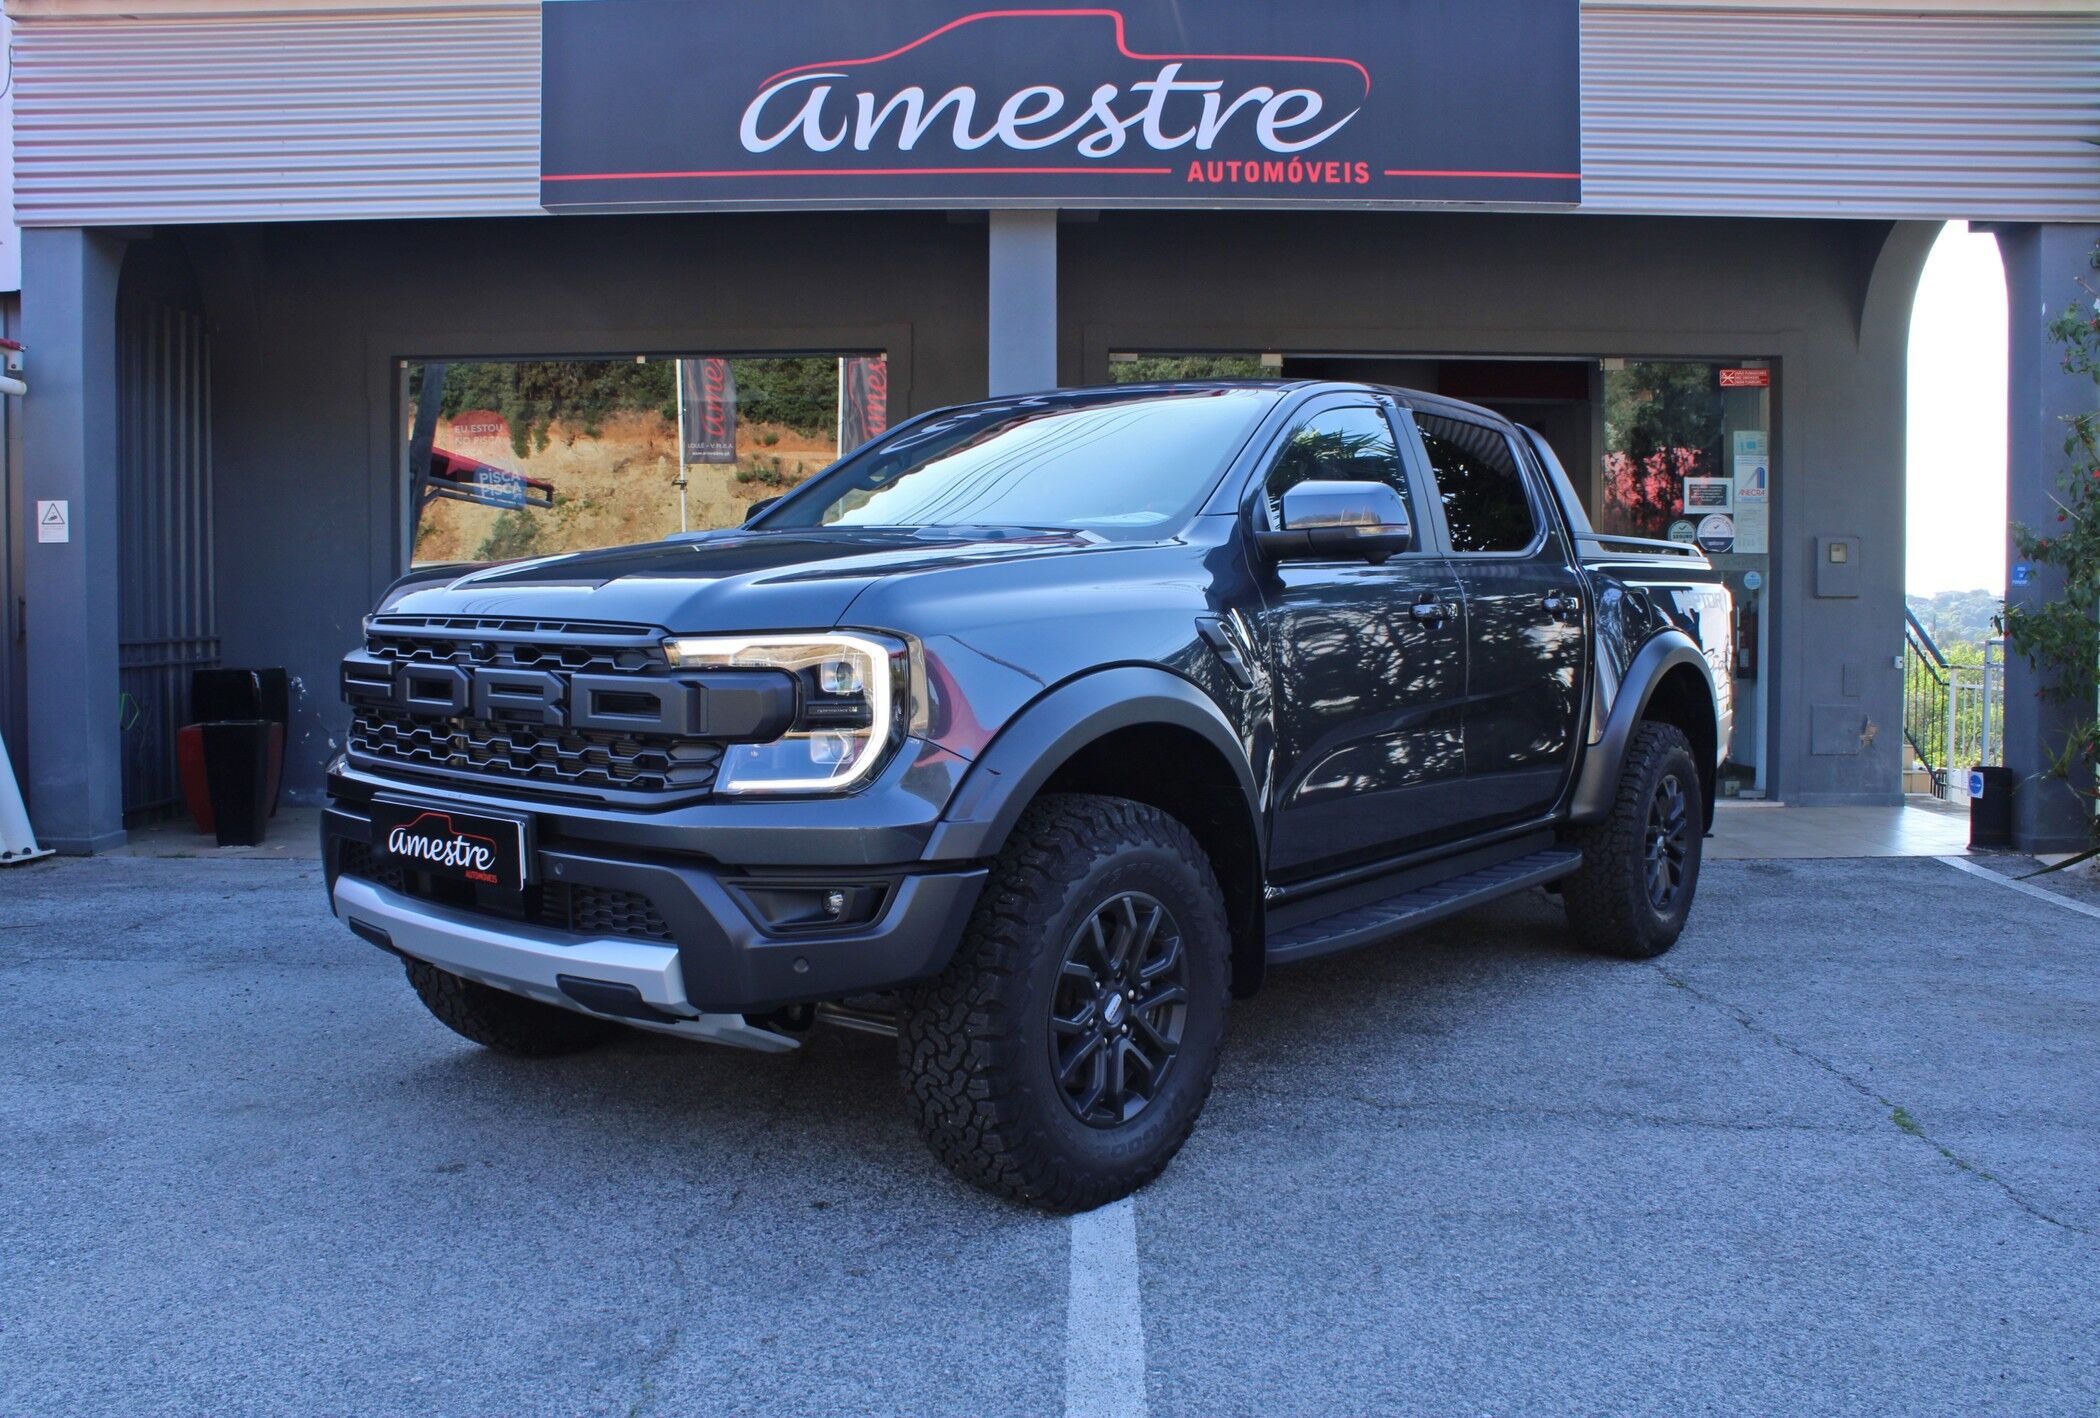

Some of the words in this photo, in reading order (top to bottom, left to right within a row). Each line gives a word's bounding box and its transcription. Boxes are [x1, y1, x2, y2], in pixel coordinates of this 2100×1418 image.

[740, 63, 1361, 158] amestre
[1187, 156, 1370, 184] AUTOMÓVEIS
[470, 423, 503, 433] ESTOU
[341, 655, 690, 736] FORD
[388, 827, 496, 870] amestre
